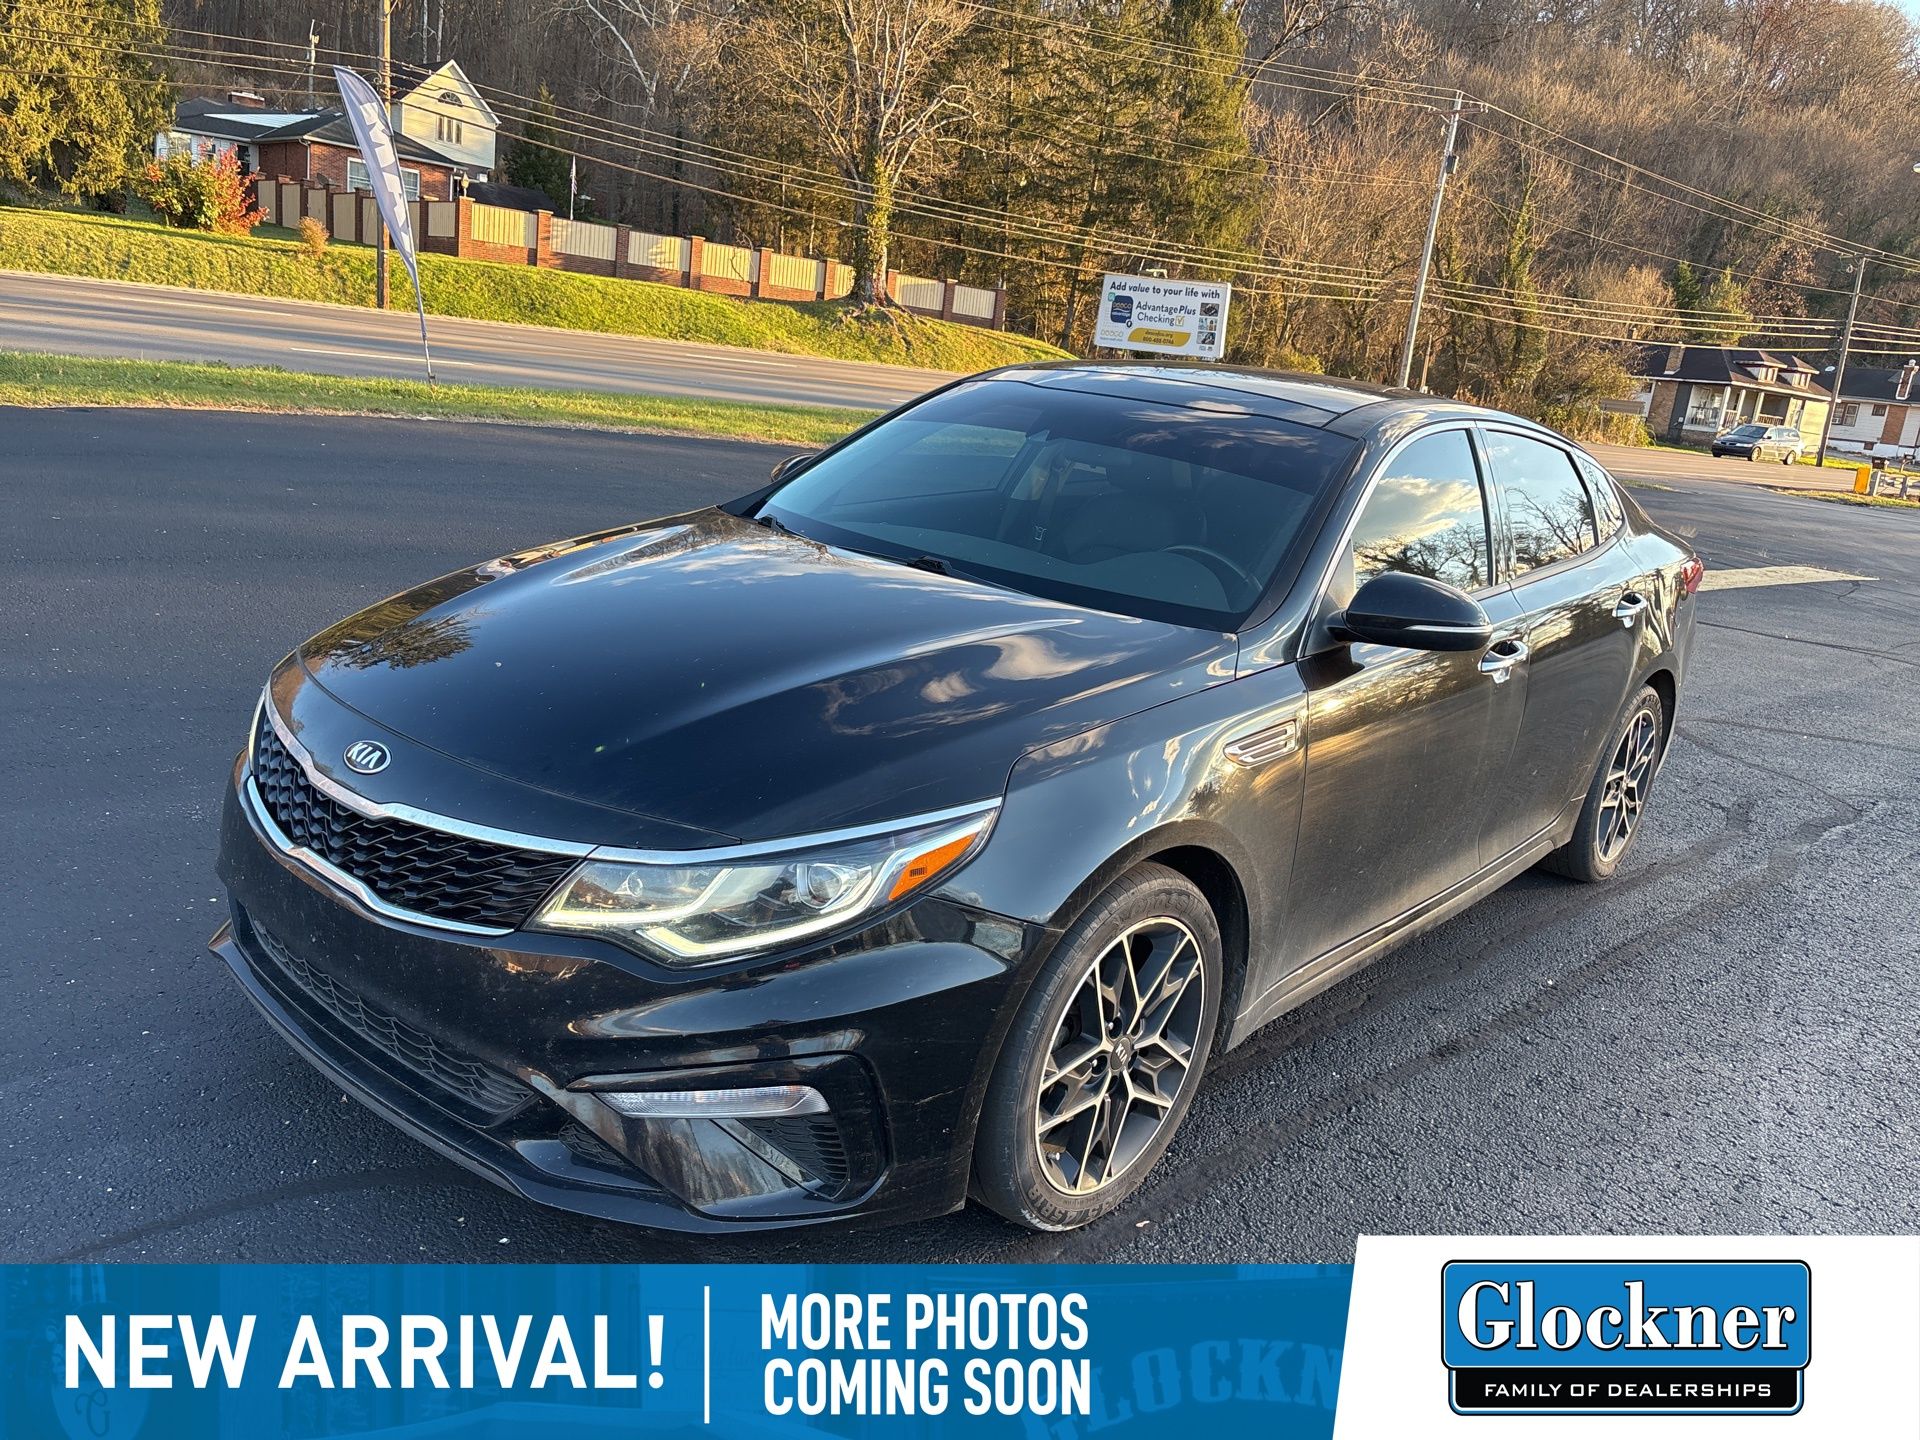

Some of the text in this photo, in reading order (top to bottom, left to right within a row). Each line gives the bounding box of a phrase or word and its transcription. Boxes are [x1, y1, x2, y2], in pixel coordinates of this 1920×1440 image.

[1110, 281, 1220, 299] Add value to your life with
[1137, 311, 1175, 327] Checking
[346, 742, 383, 769] KIA
[1115, 1042, 1128, 1065] KIA
